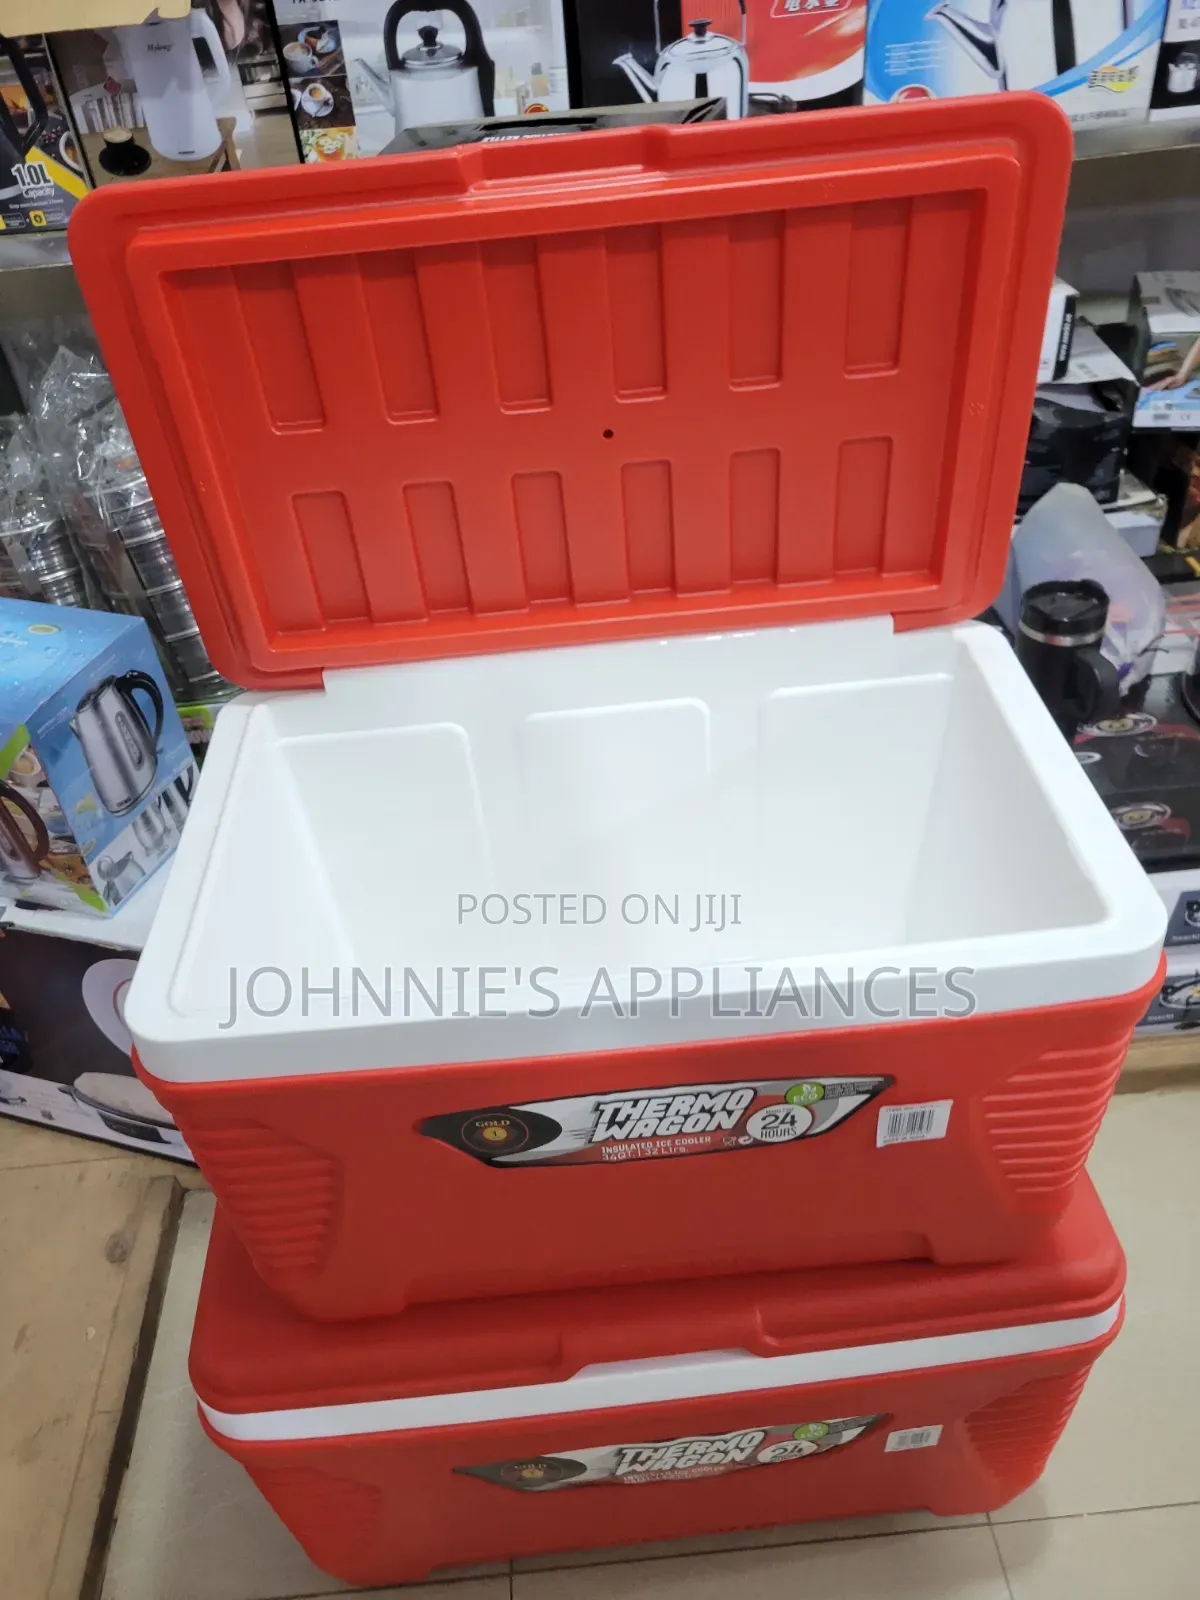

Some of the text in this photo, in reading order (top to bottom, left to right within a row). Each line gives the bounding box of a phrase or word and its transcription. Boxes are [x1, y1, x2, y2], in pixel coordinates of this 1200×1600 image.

[11, 161, 54, 189] 1.0L
[23, 187, 55, 199] Capacity
[598, 1087, 755, 1122] THERMO
[591, 1107, 745, 1143] WAGON
[760, 1111, 798, 1129] 24
[760, 1126, 797, 1139] HOURS
[601, 1142, 653, 1154] INSULATED
[656, 1139, 671, 1148] ICE
[675, 1136, 711, 1146] COOLER
[614, 1446, 756, 1475] WAGON
[621, 1431, 765, 1462] THERMO
